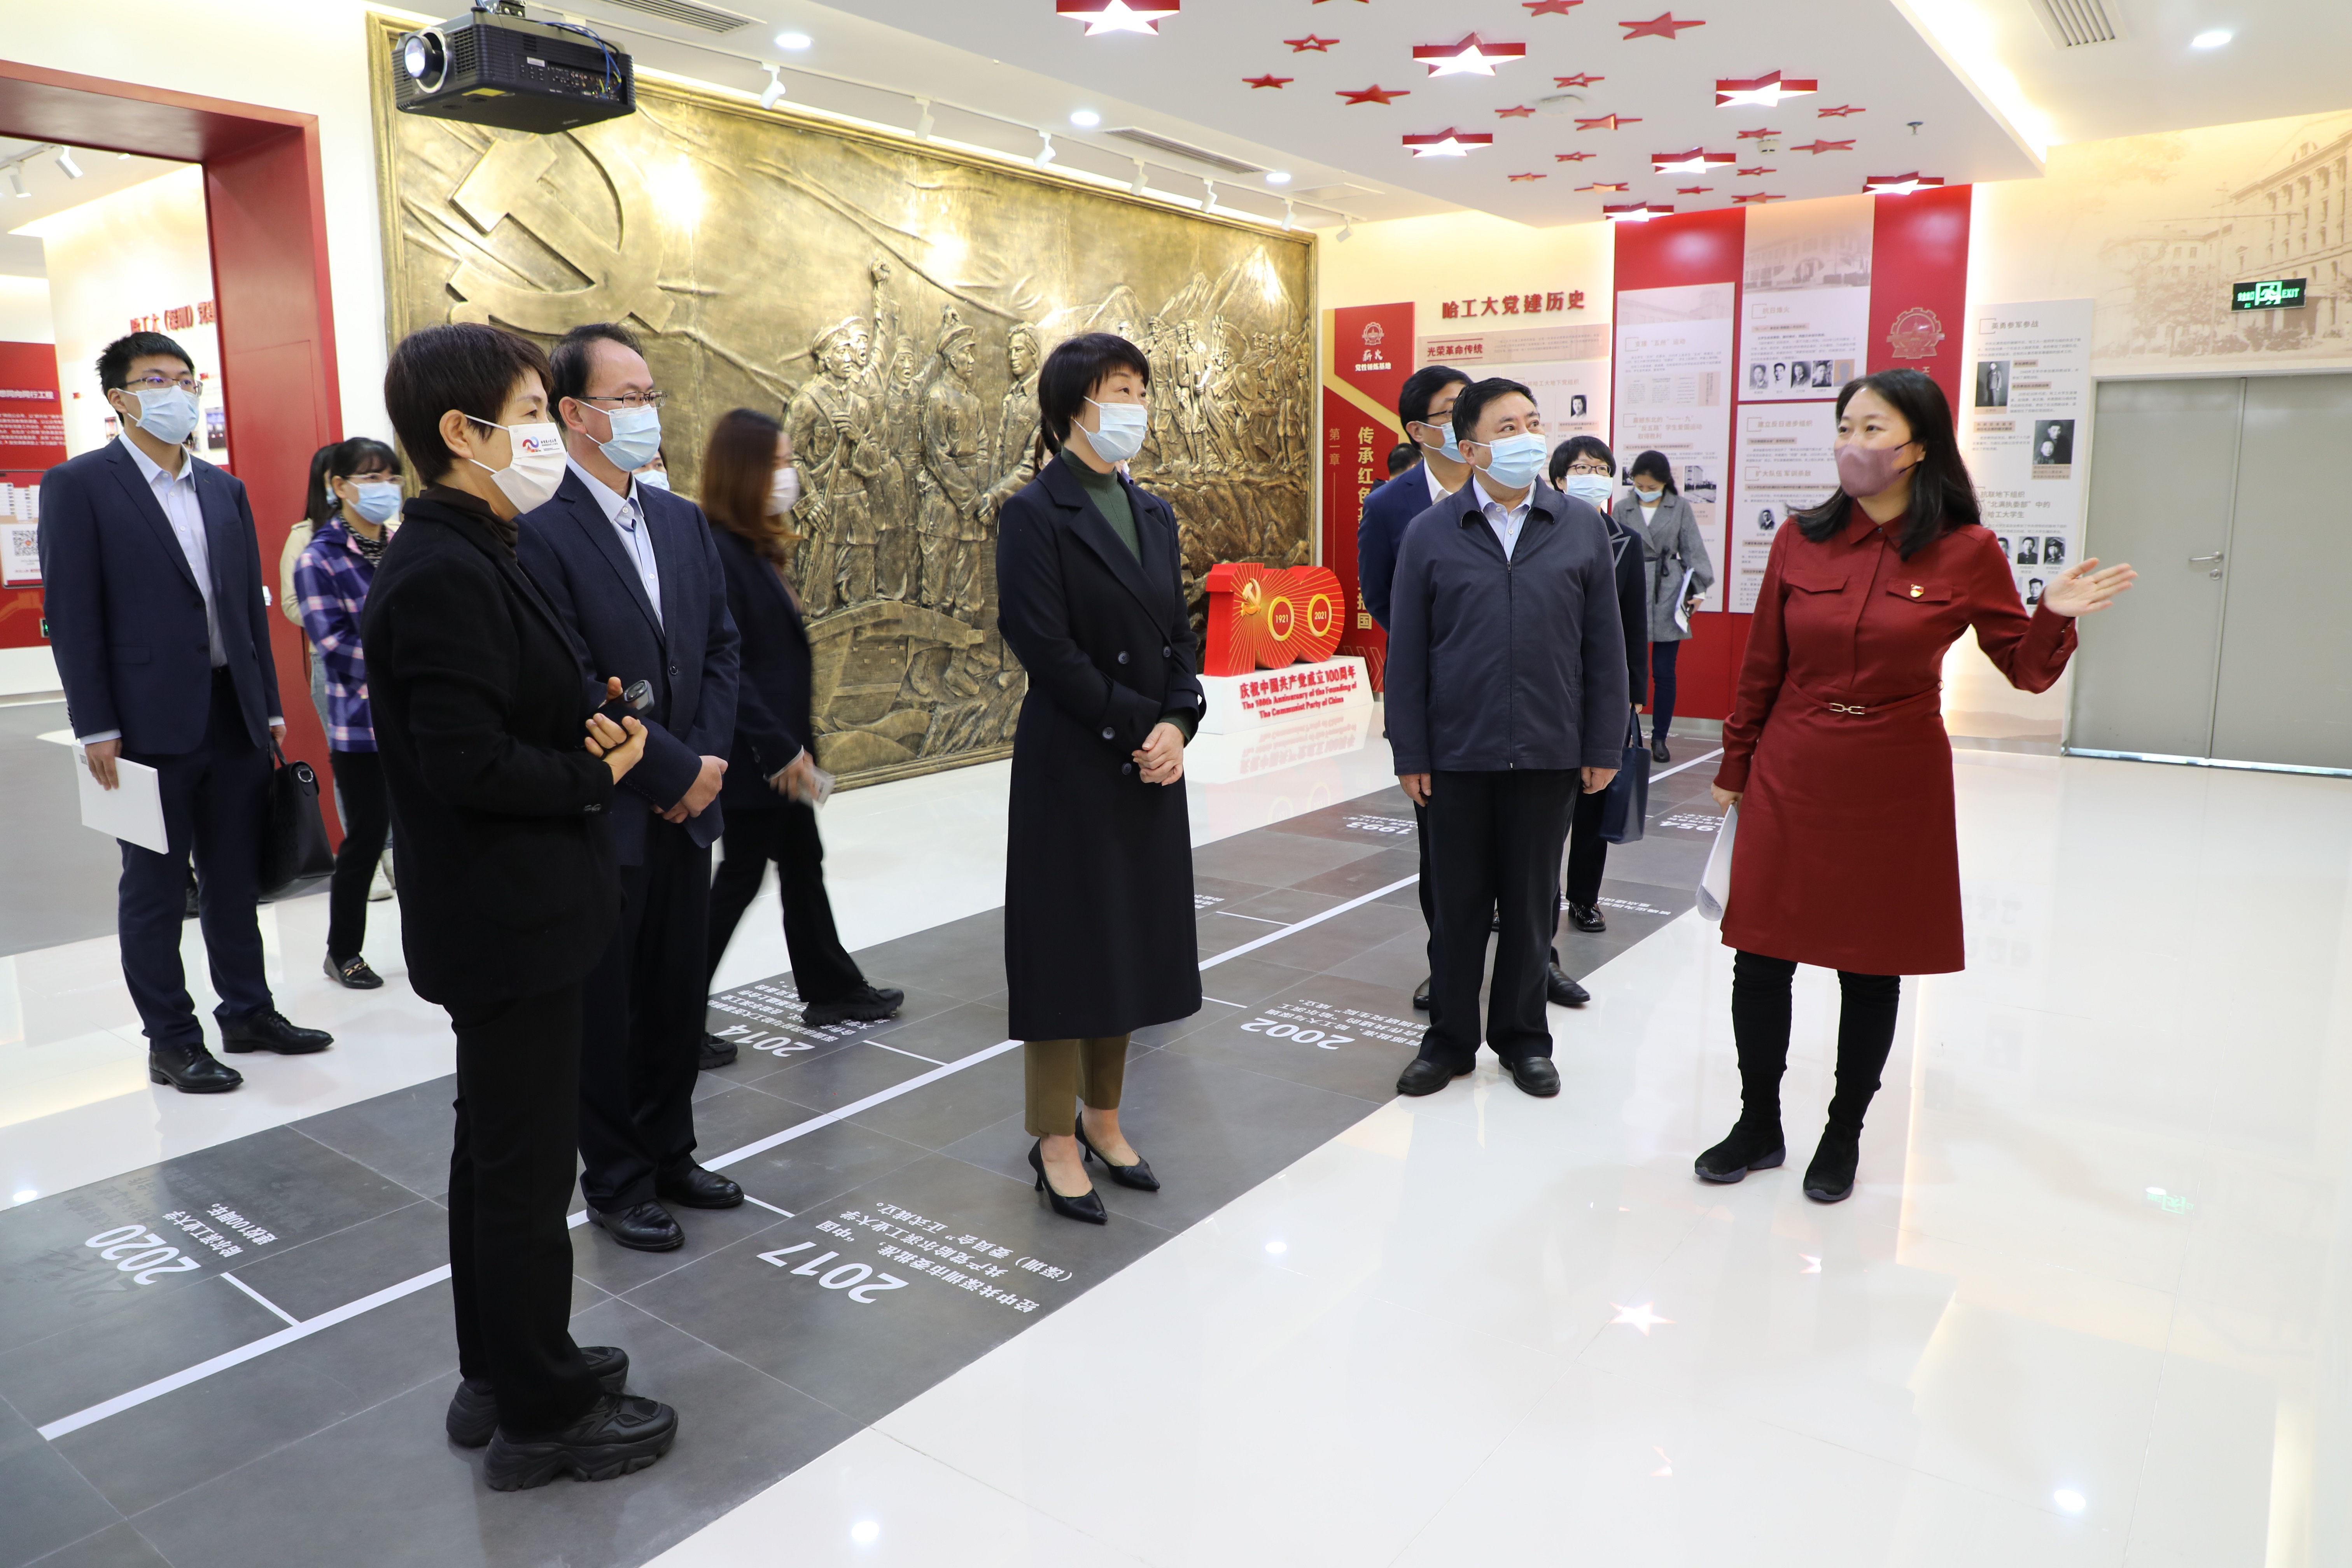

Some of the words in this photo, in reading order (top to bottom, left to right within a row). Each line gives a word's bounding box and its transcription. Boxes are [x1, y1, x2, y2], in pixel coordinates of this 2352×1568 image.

[1442, 290, 1585, 318] 哈工大党建历史
[2282, 288, 2300, 298] EXIT
[1991, 320, 2039, 329] 英勇参军参战
[1427, 343, 1483, 357] 光荣革命传统
[1329, 428, 1340, 466] 第一章
[1275, 614, 1289, 623] 1921
[1314, 611, 1327, 620] 2021
[1239, 665, 1356, 699] 庆祝中国共产党成立100周年
[1242, 701, 1254, 710] The
[1255, 697, 1272, 707] 100th
[1273, 692, 1308, 704] Anniversary
[1309, 689, 1315, 697] of
[1316, 688, 1325, 696] the
[1326, 683, 1351, 693] Founding
[1259, 710, 1270, 719] The
[1272, 703, 1306, 716] Communist
[1306, 700, 1321, 709] Party
[1328, 696, 1344, 705] China
[1346, 822, 1412, 834] 1993
[1659, 821, 1721, 833] 954
[713, 1024, 816, 1057] 2014
[1241, 1017, 1356, 1050] 2002
[162, 1210, 244, 1258] 哈尔滨工业大学
[840, 1211, 1009, 1278] 共产党哈尔滨工业大学
[85, 1224, 202, 1285] 2020
[756, 1241, 909, 1304] 2017
